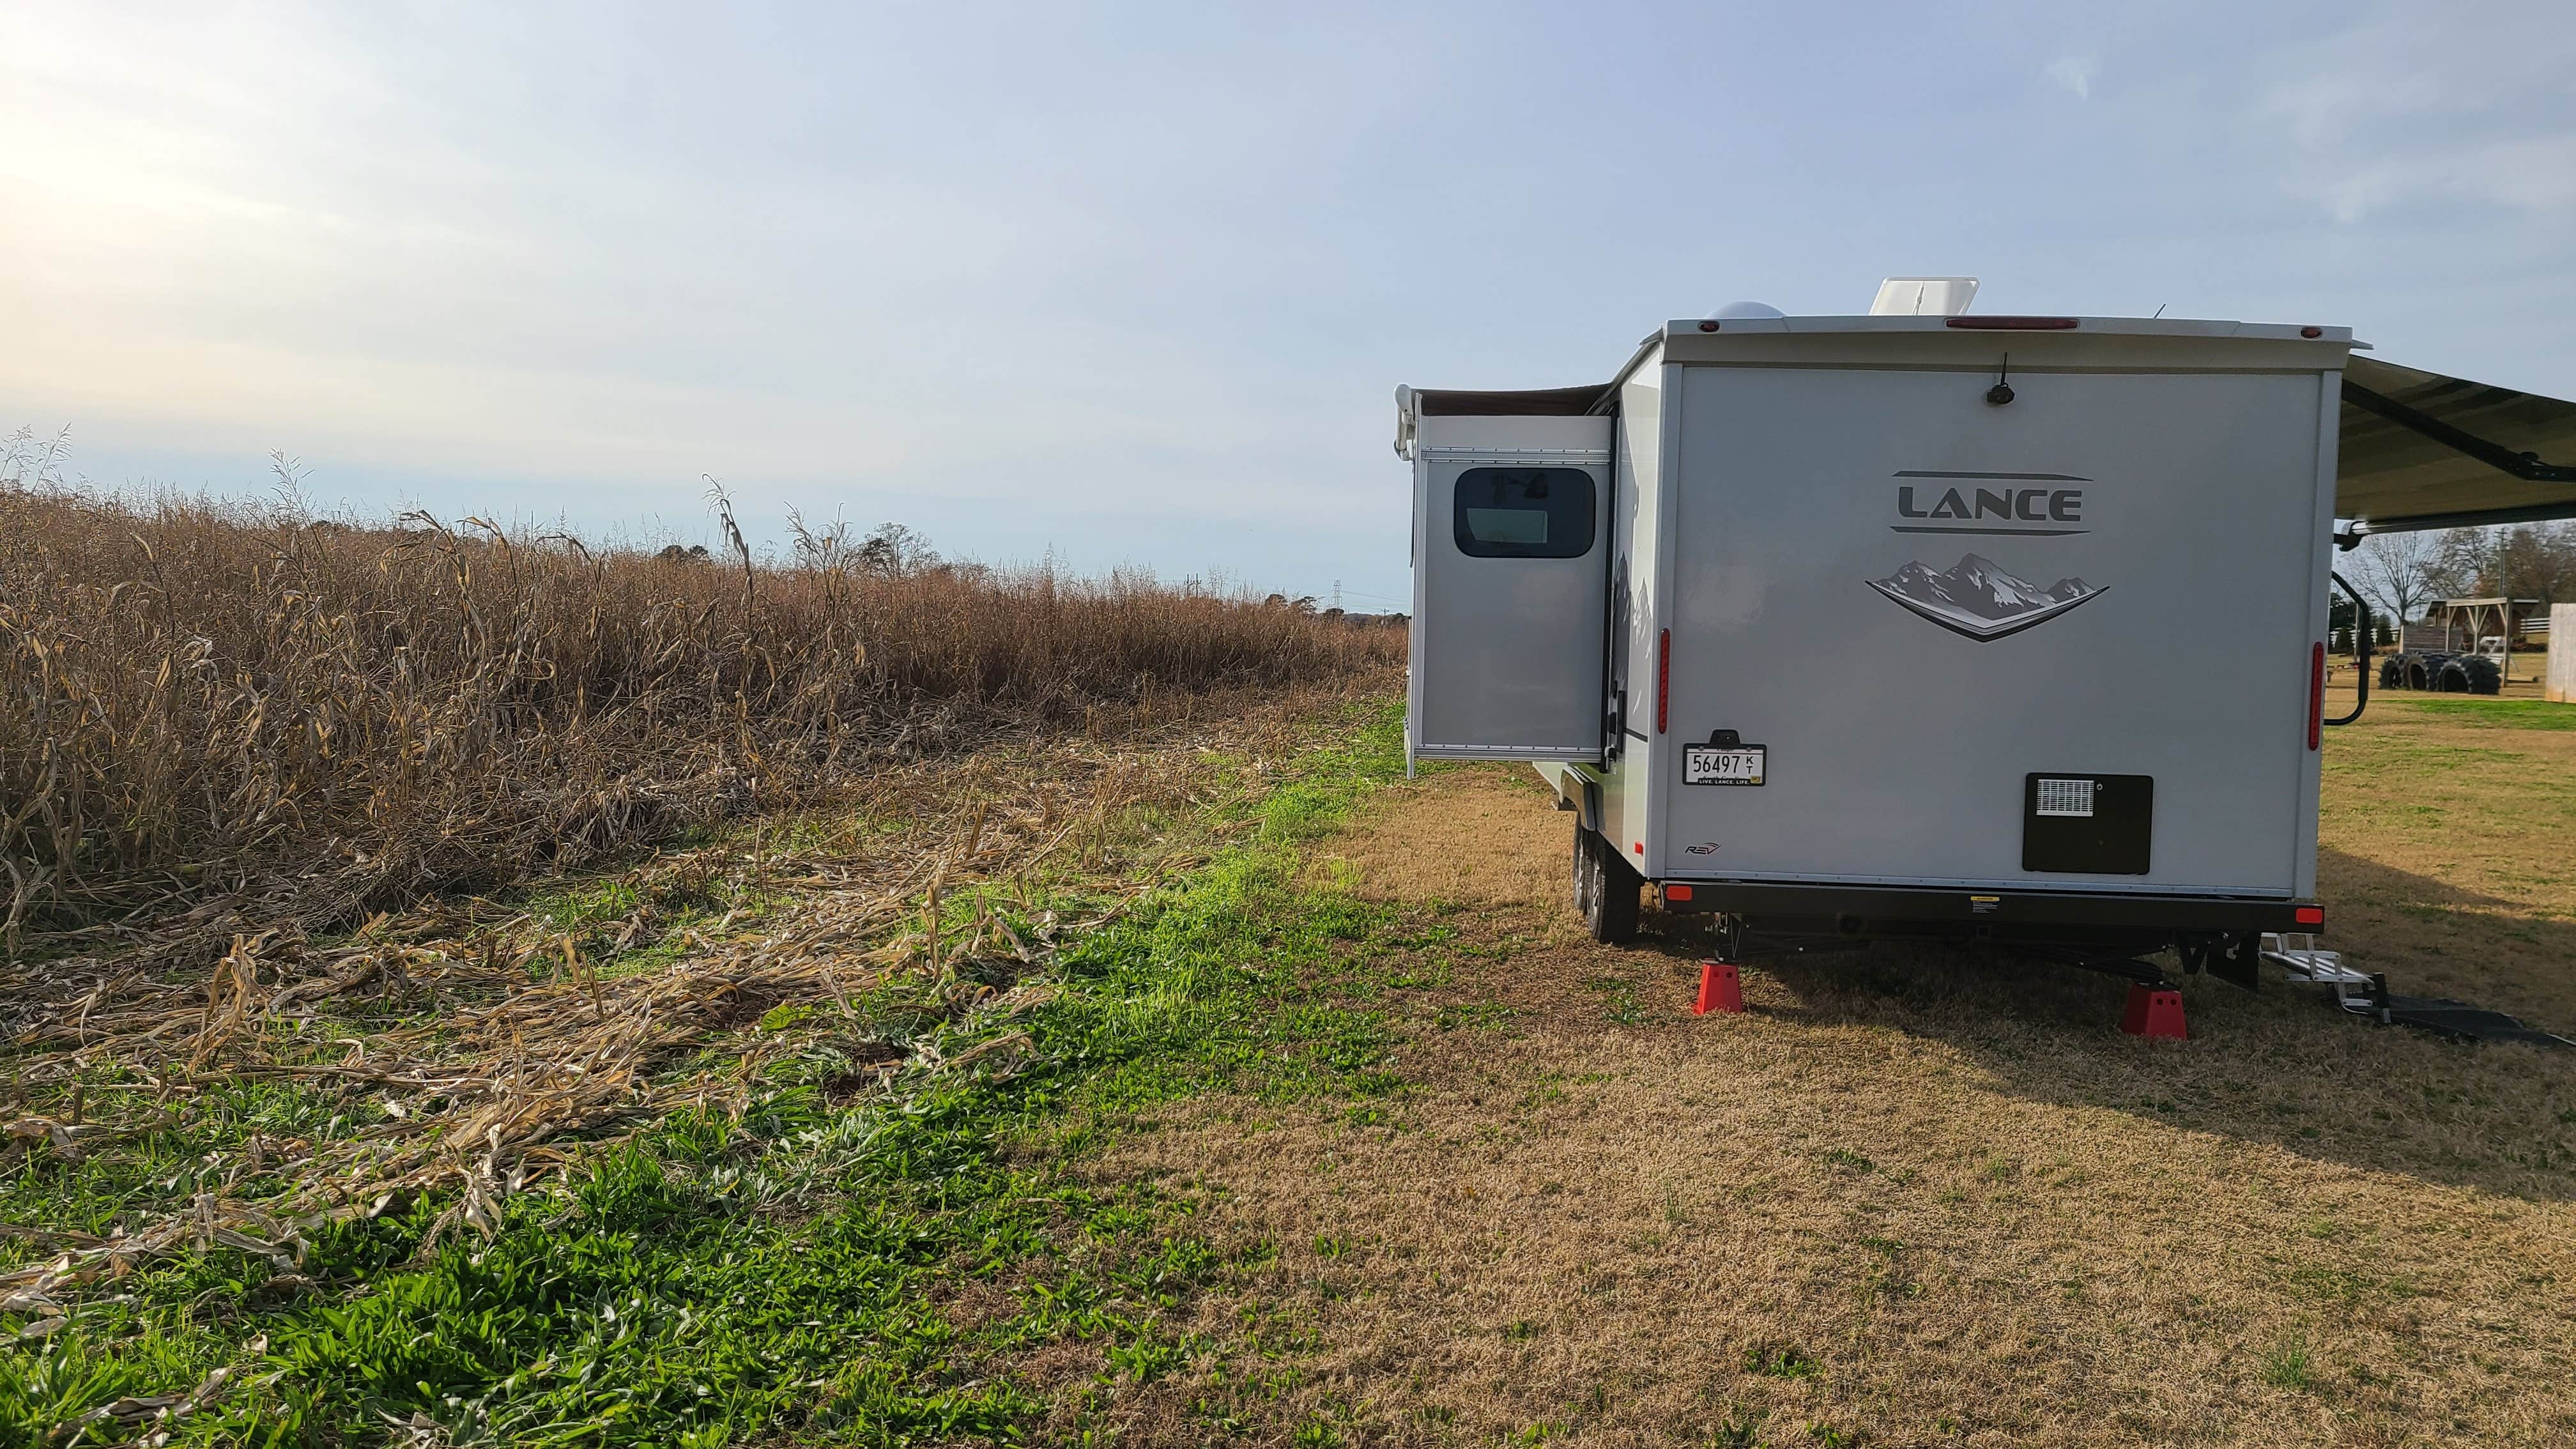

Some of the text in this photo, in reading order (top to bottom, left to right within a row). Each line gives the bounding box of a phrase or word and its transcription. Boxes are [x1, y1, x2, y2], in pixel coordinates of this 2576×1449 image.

[1897, 486, 2083, 522] LANCE
[1693, 755, 1740, 774] 56497
[1685, 843, 1722, 855] REV
